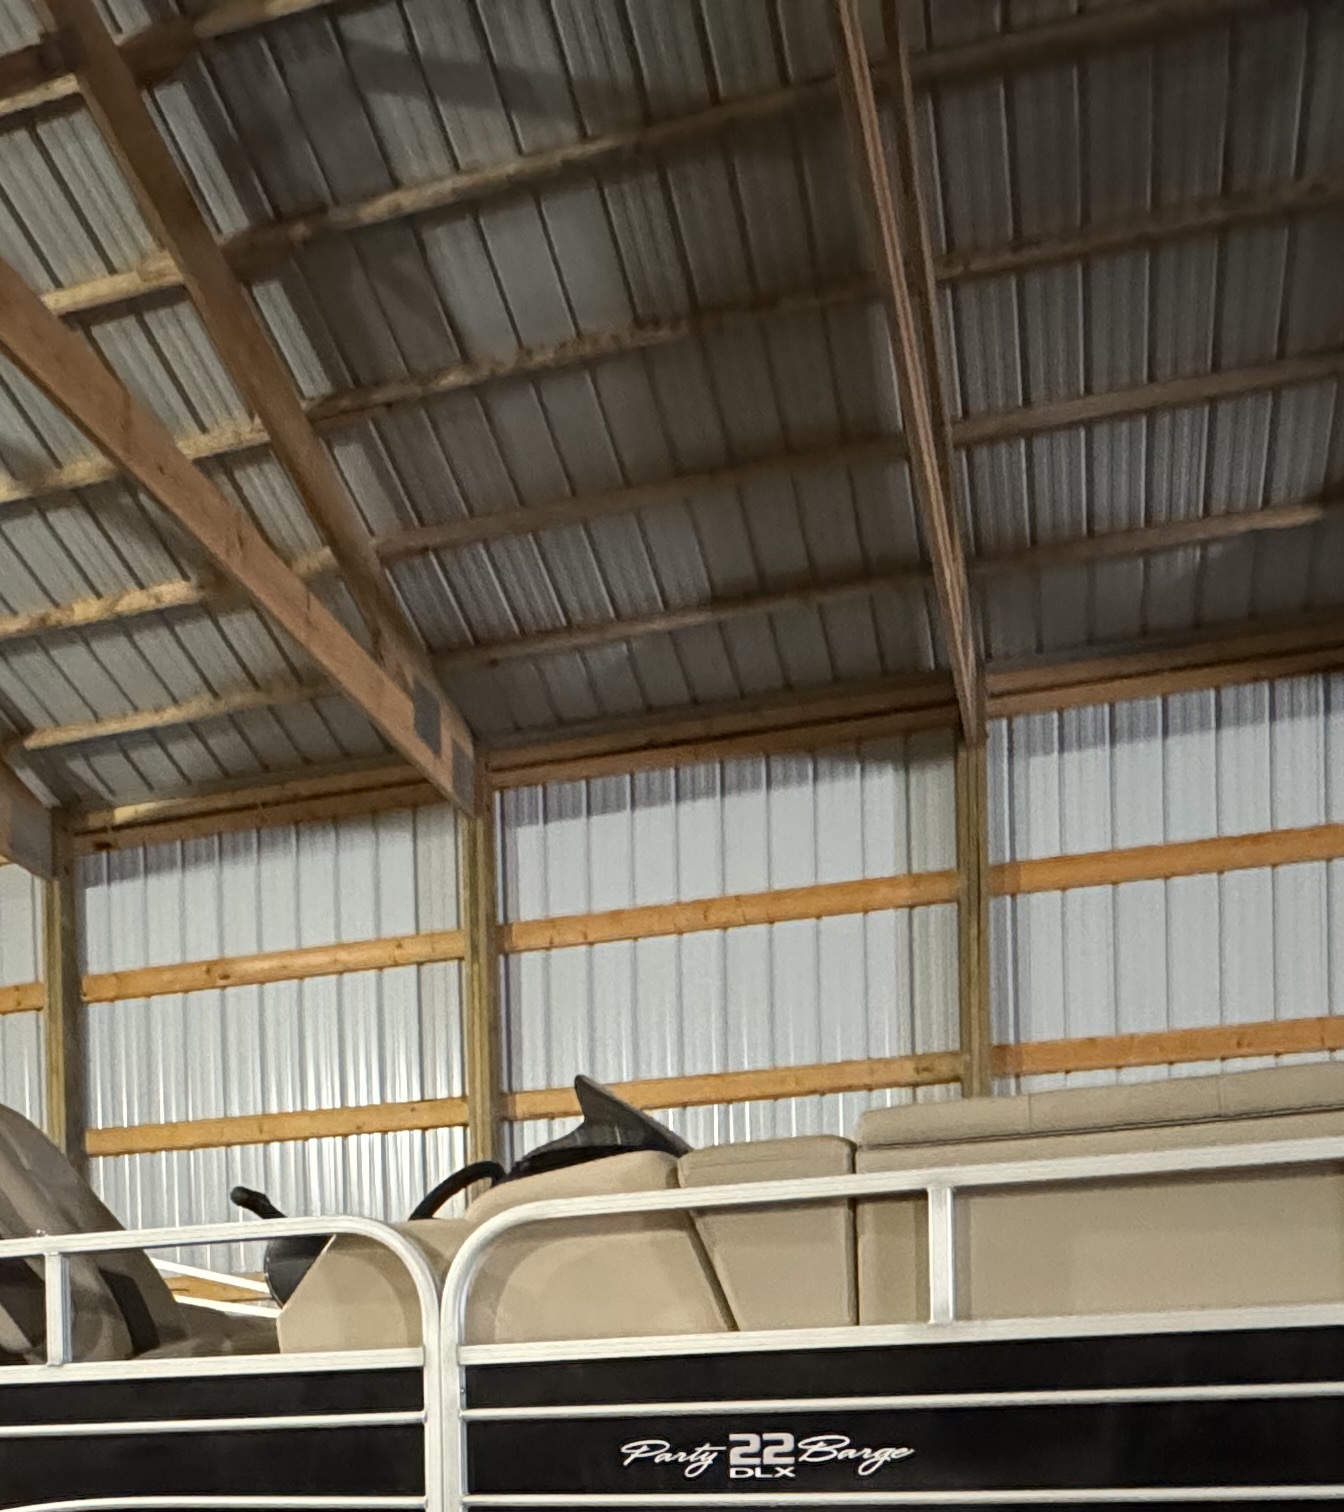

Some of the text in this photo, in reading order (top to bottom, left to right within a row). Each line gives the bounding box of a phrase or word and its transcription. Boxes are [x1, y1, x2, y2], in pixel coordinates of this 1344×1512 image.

[620, 1432, 914, 1478] Party 22 Barge
[729, 1466, 796, 1479] DLX
